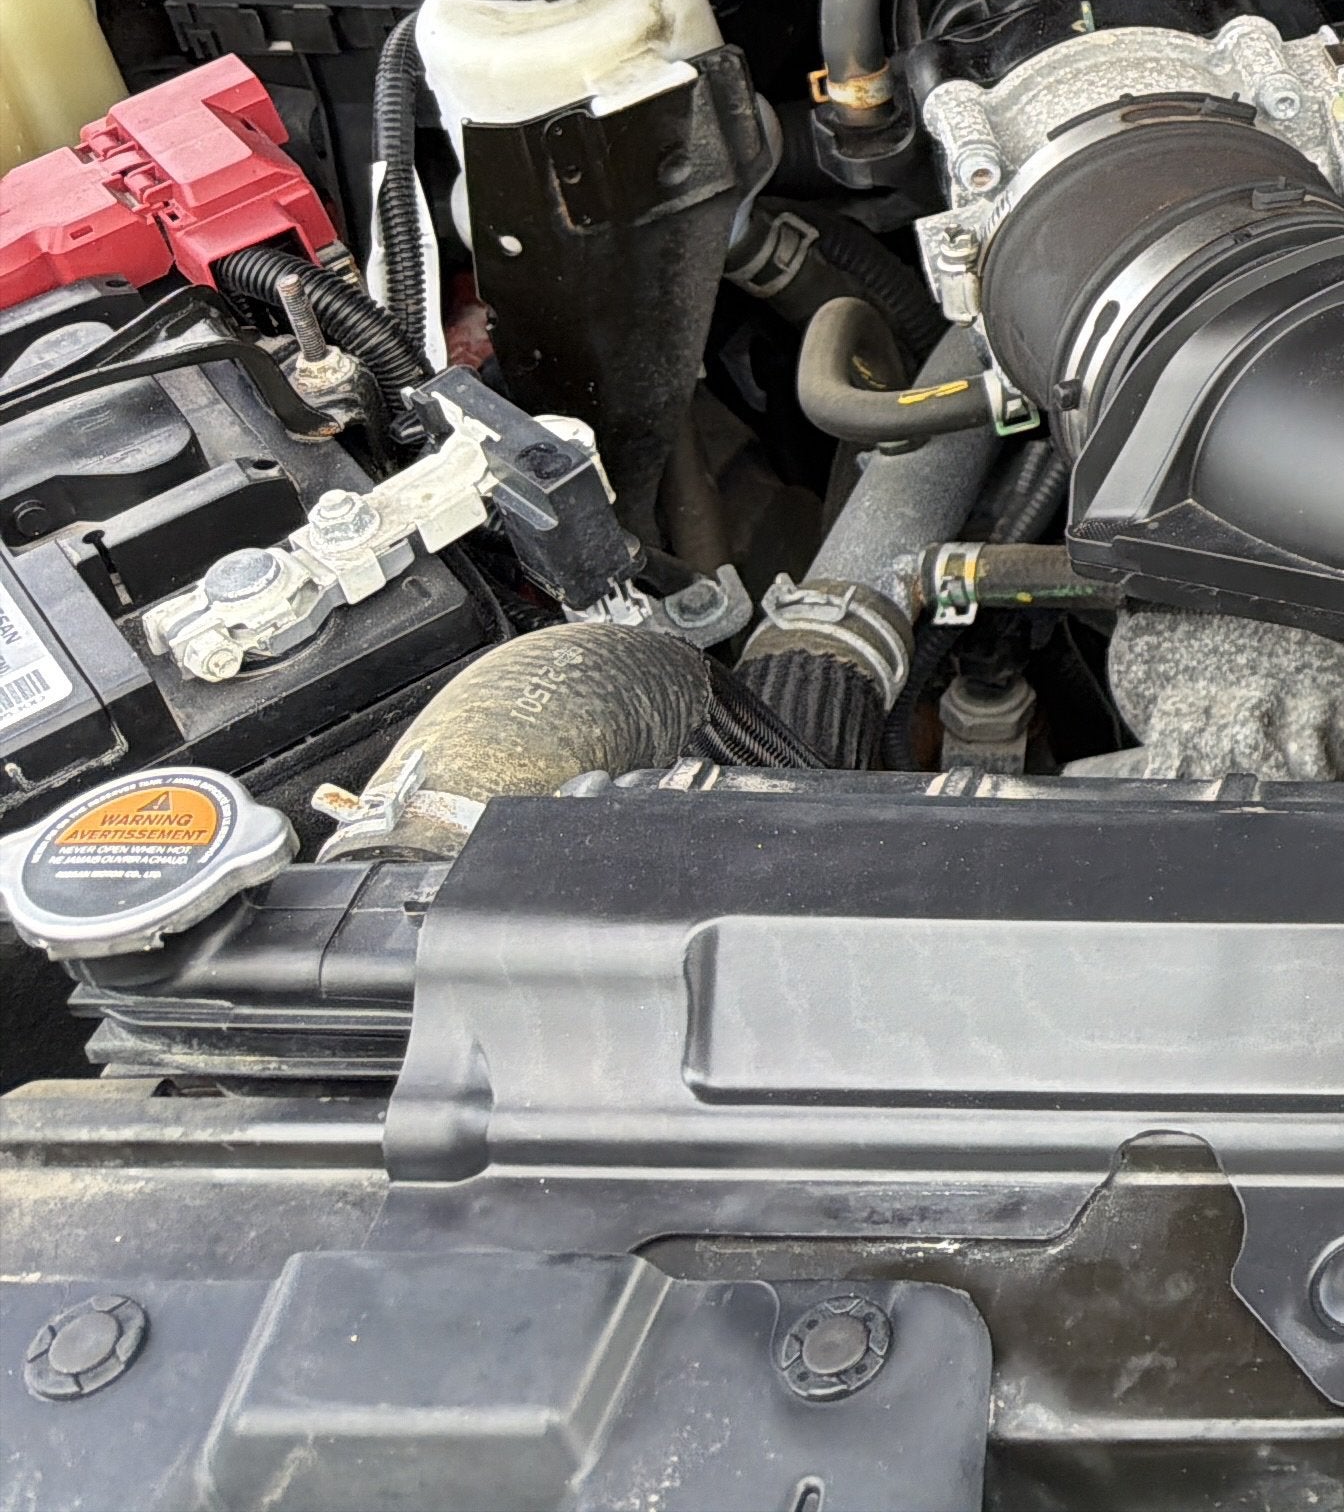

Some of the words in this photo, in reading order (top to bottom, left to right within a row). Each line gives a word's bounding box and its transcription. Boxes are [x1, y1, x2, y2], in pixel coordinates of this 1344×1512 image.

[100, 814, 193, 827] WARNING
[65, 829, 208, 841] AVERTISSEMENT
[59, 845, 96, 854] NEVER
[96, 845, 130, 854] OPEN
[131, 845, 164, 854] WHEN
